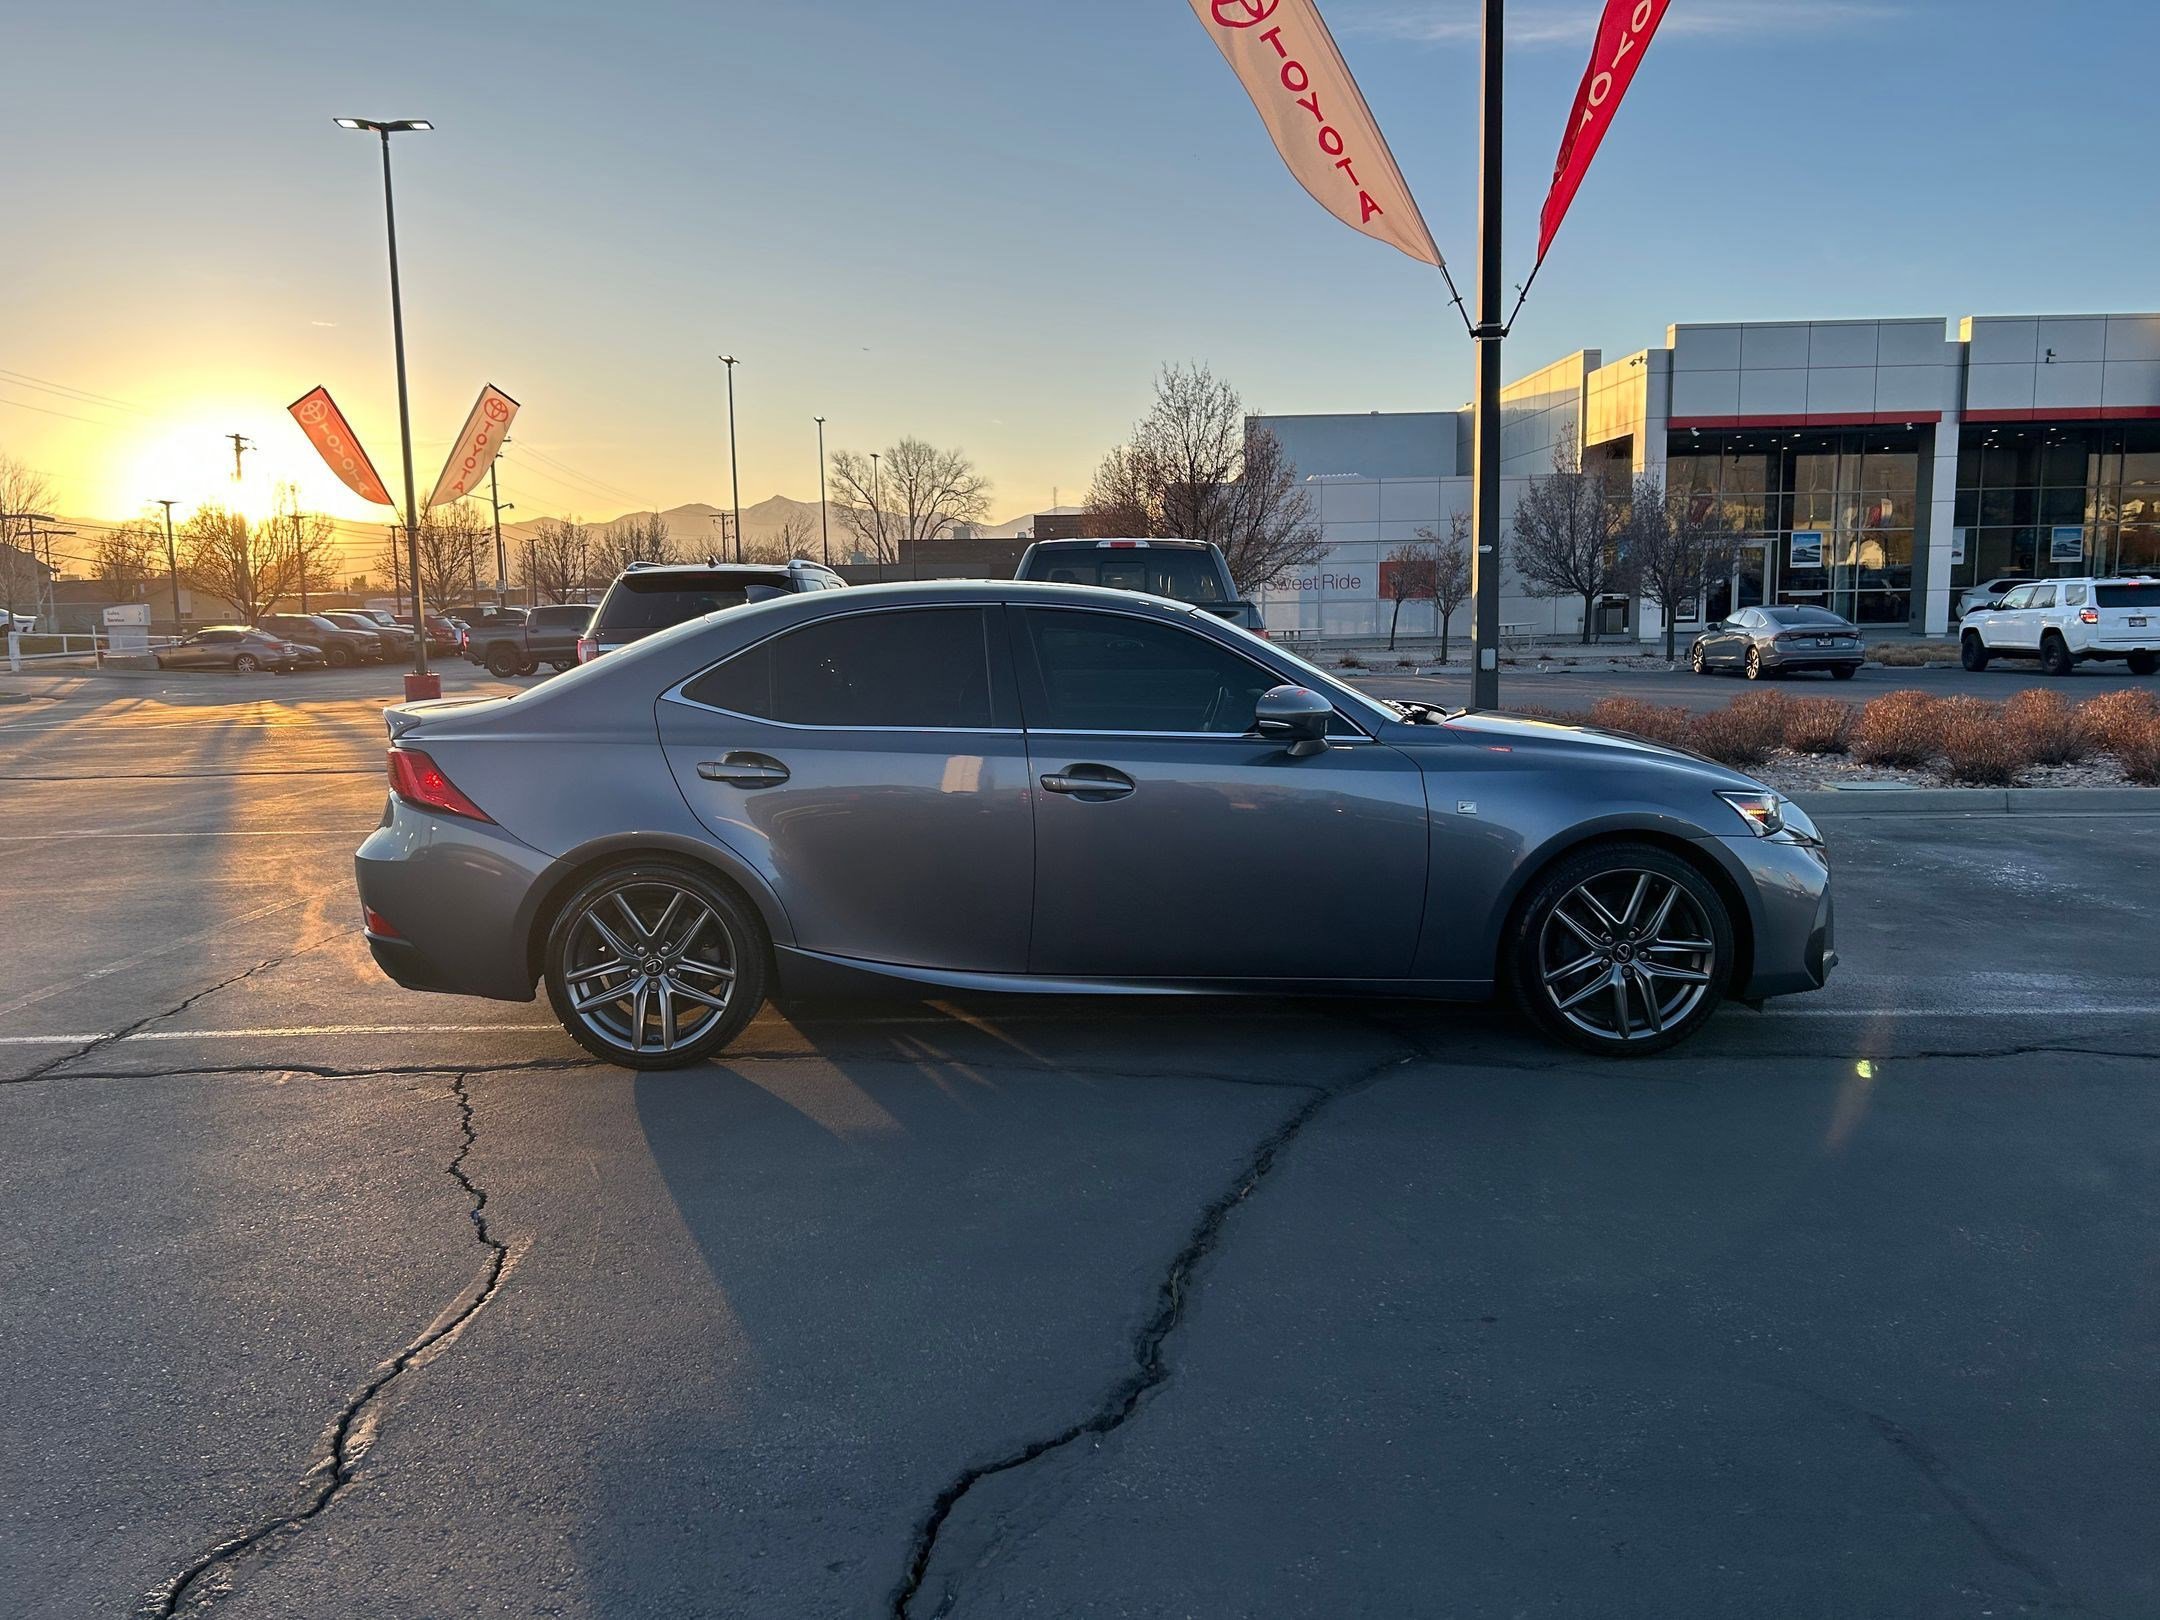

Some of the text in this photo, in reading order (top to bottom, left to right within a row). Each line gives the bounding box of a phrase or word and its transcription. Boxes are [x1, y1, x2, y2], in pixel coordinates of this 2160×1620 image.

[1260, 26, 1384, 225] TOYOTA
[318, 423, 371, 495] TOYOTA
[452, 421, 497, 494] TOYOTA
[1264, 575, 1319, 592] Sweet
[1322, 574, 1362, 591] Ride
